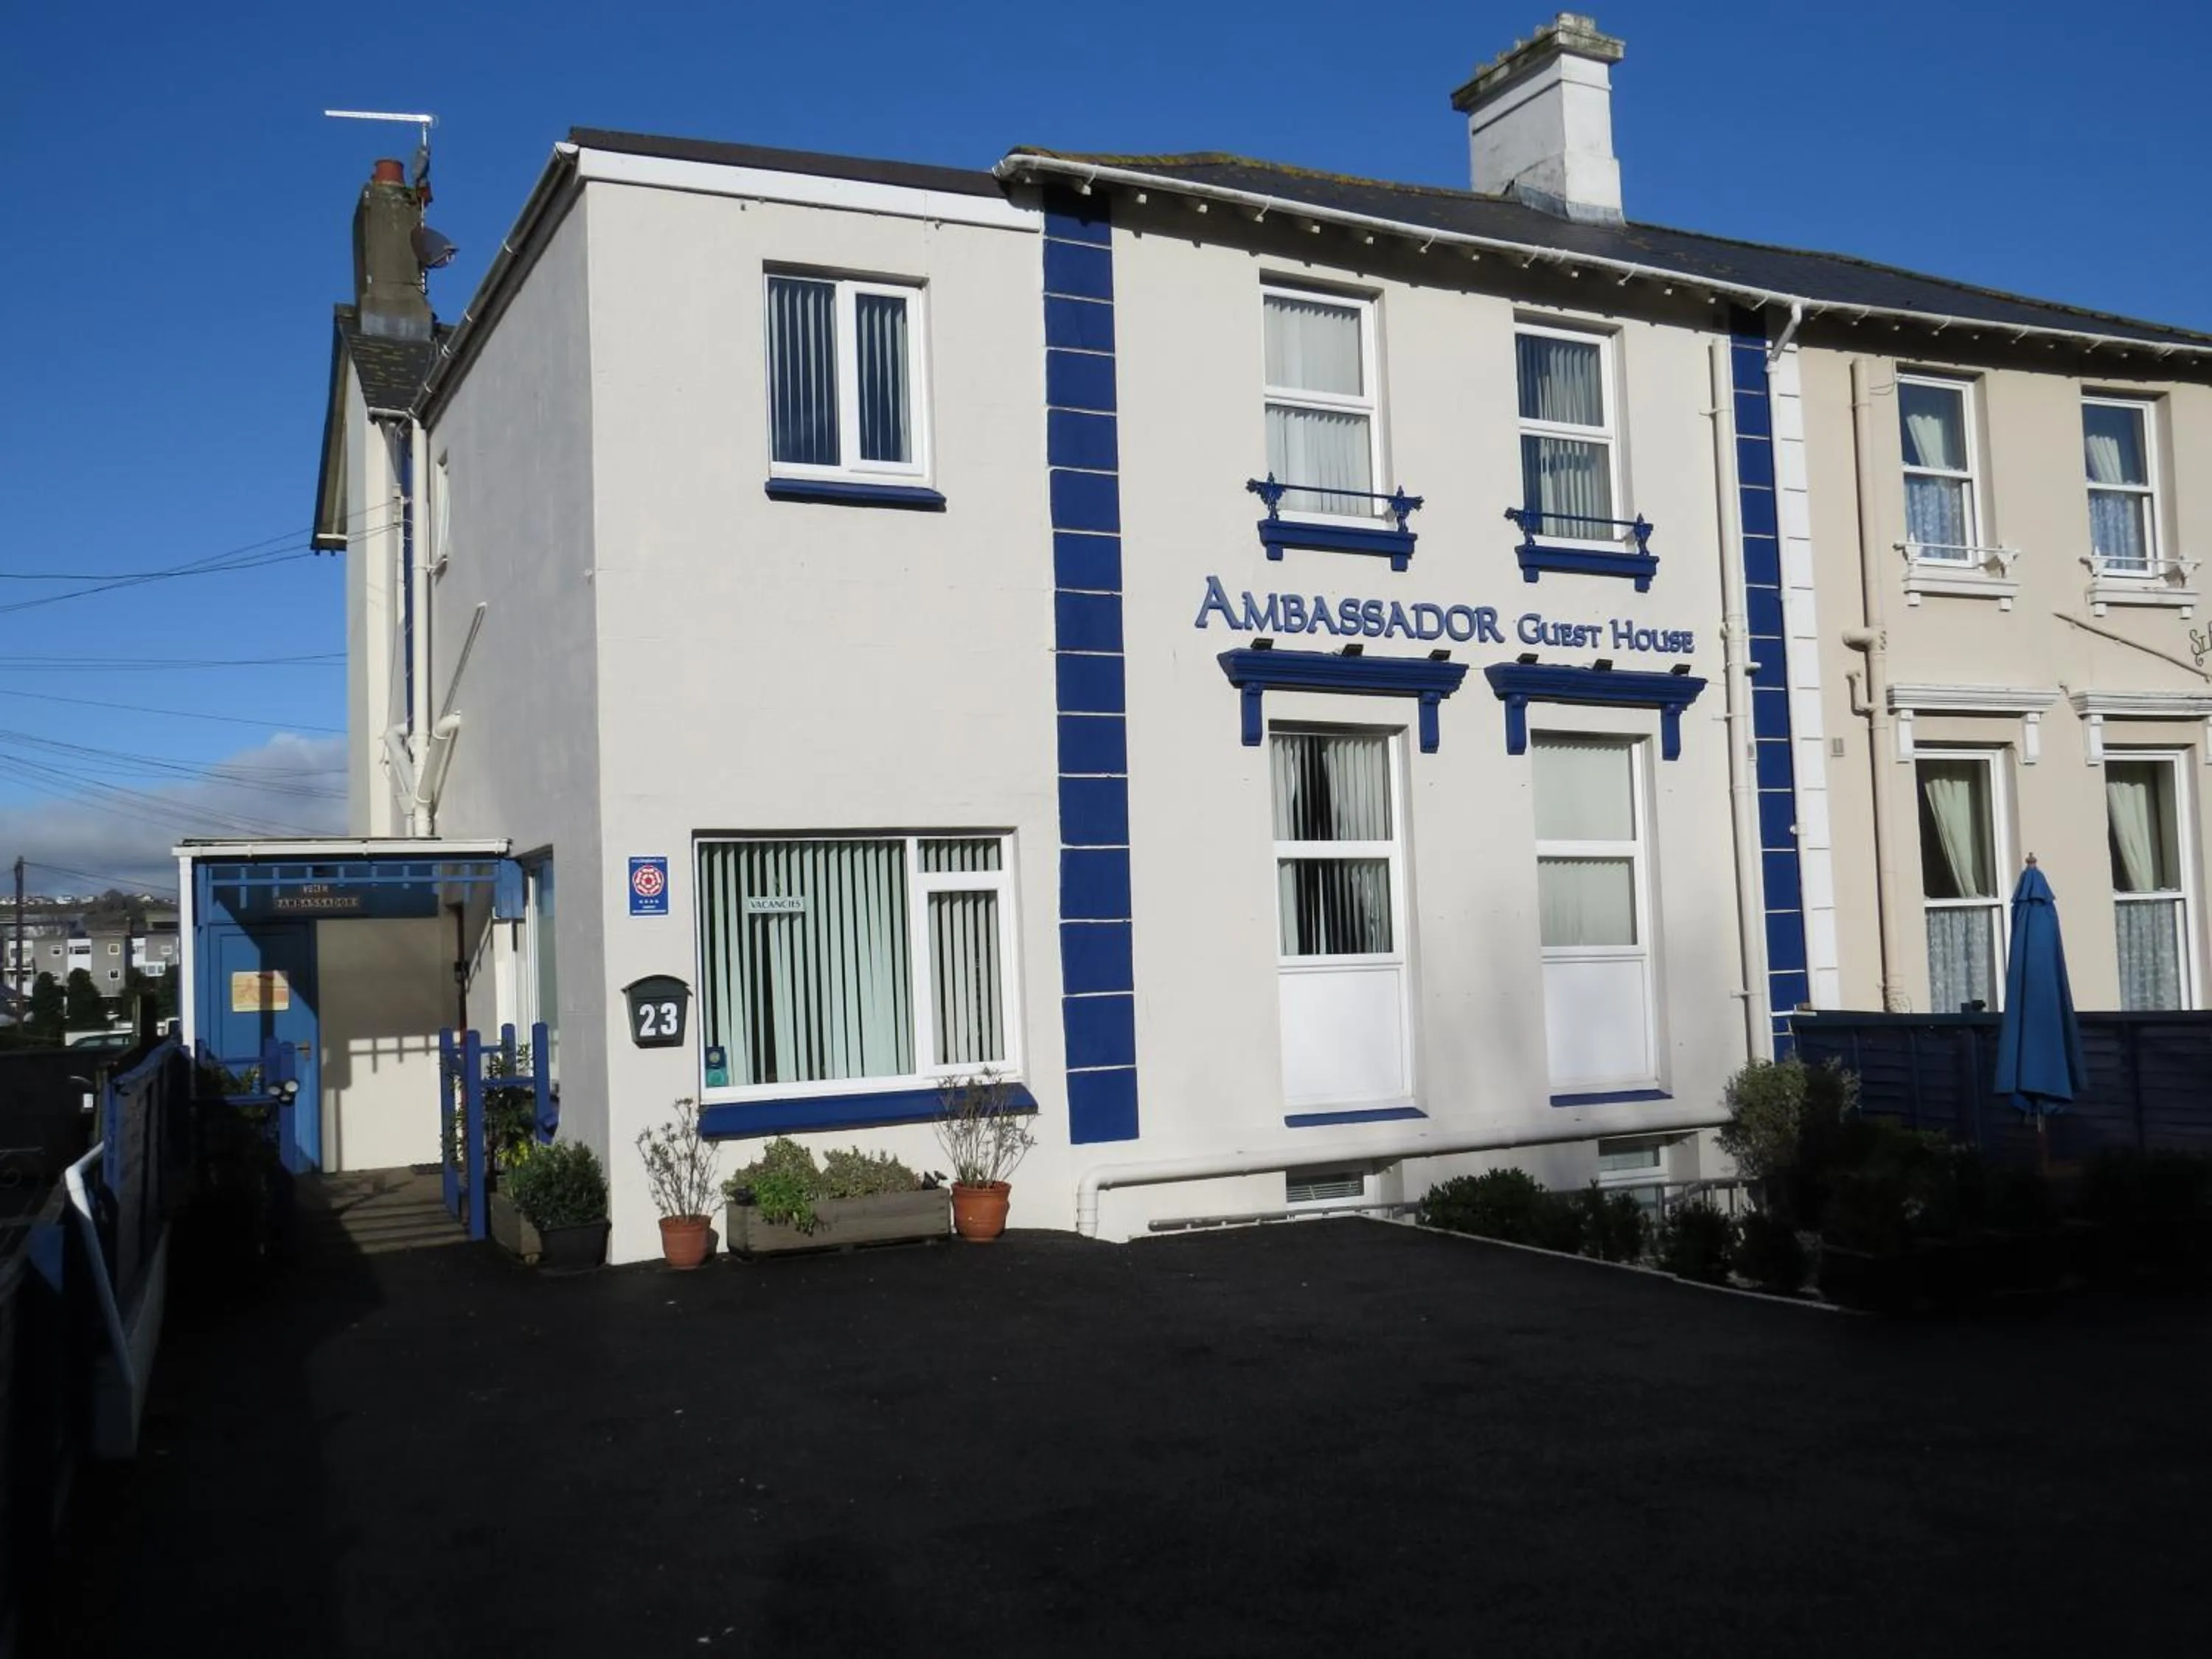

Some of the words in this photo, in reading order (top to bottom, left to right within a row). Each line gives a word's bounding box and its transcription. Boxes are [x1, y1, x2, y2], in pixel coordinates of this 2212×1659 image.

[1194, 575, 1506, 644] AMBASSADOR
[1517, 613, 1603, 649] GUEST
[1609, 619, 1695, 654] HOUSE
[750, 900, 801, 909] VACANCIES
[639, 1003, 678, 1037] 23
